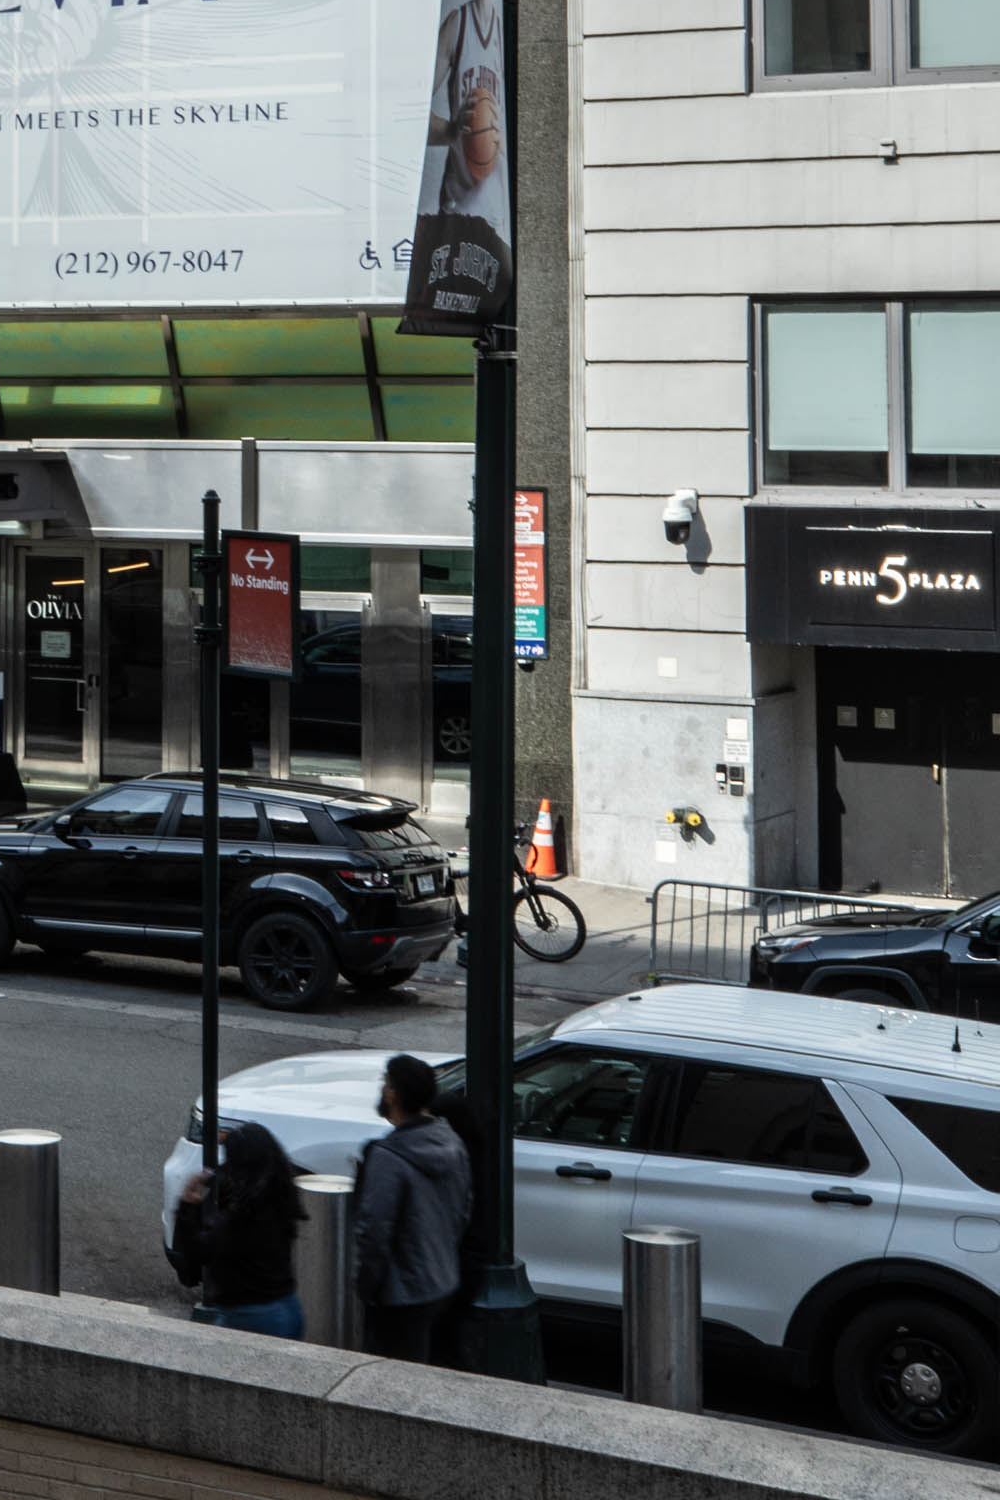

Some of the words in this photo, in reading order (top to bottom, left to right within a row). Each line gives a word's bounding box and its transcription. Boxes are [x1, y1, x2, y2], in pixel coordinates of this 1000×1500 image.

[15, 109, 100, 130] MEETS
[111, 107, 161, 127] THE
[173, 101, 289, 125] SKYLINE
[55, 250, 119, 280] (212)
[126, 249, 244, 274] 967-8047
[231, 572, 244, 587] No
[246, 574, 289, 595] Standing
[819, 569, 877, 587] PENN
[875, 555, 908, 605] 5
[907, 572, 981, 590] PLAZA
[26, 599, 83, 620] OLIVIA
